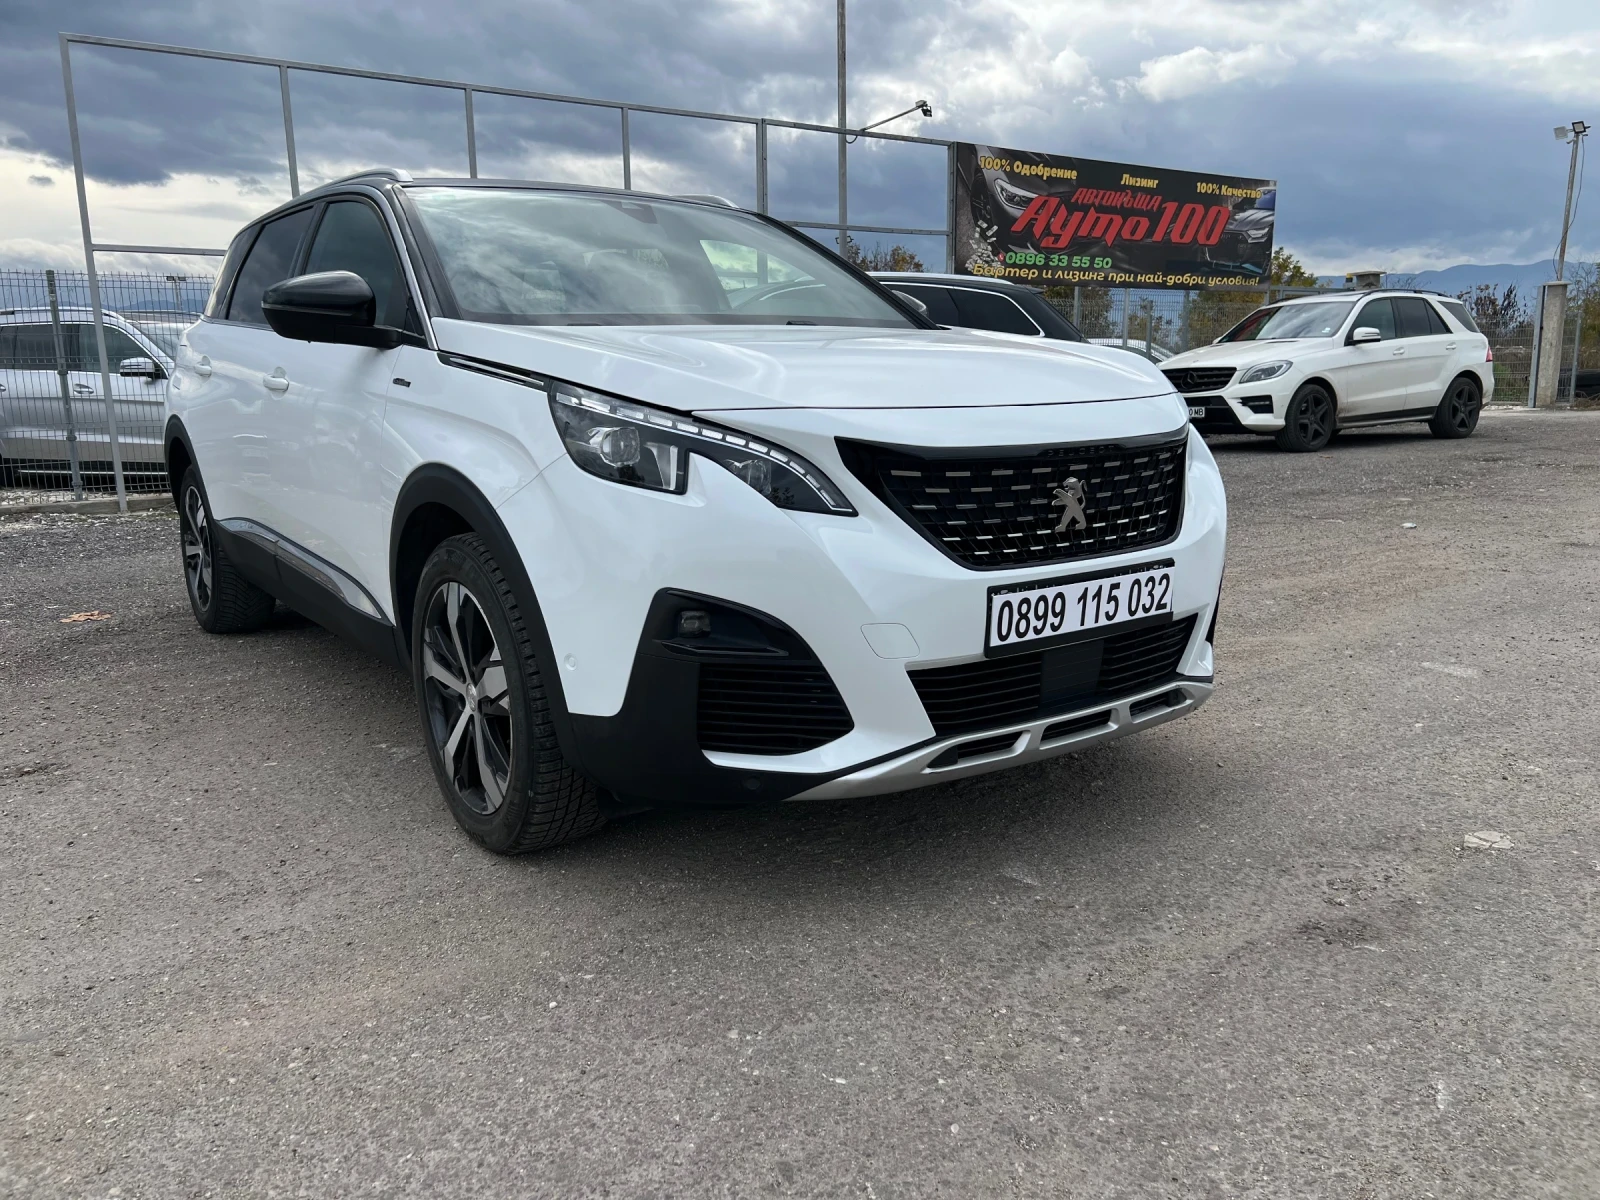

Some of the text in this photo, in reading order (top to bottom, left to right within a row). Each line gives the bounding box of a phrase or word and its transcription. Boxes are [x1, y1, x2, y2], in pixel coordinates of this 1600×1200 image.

[980, 156, 1078, 180] 100% Одобрение
[1120, 174, 1159, 189] Лизинг
[1196, 182, 1263, 199] 100% Качество
[1005, 252, 1112, 269] 0896 33 55 50
[973, 263, 1260, 287] Бартер и лизинг при най-добри условия!
[997, 573, 1171, 642] 0899 115 032
